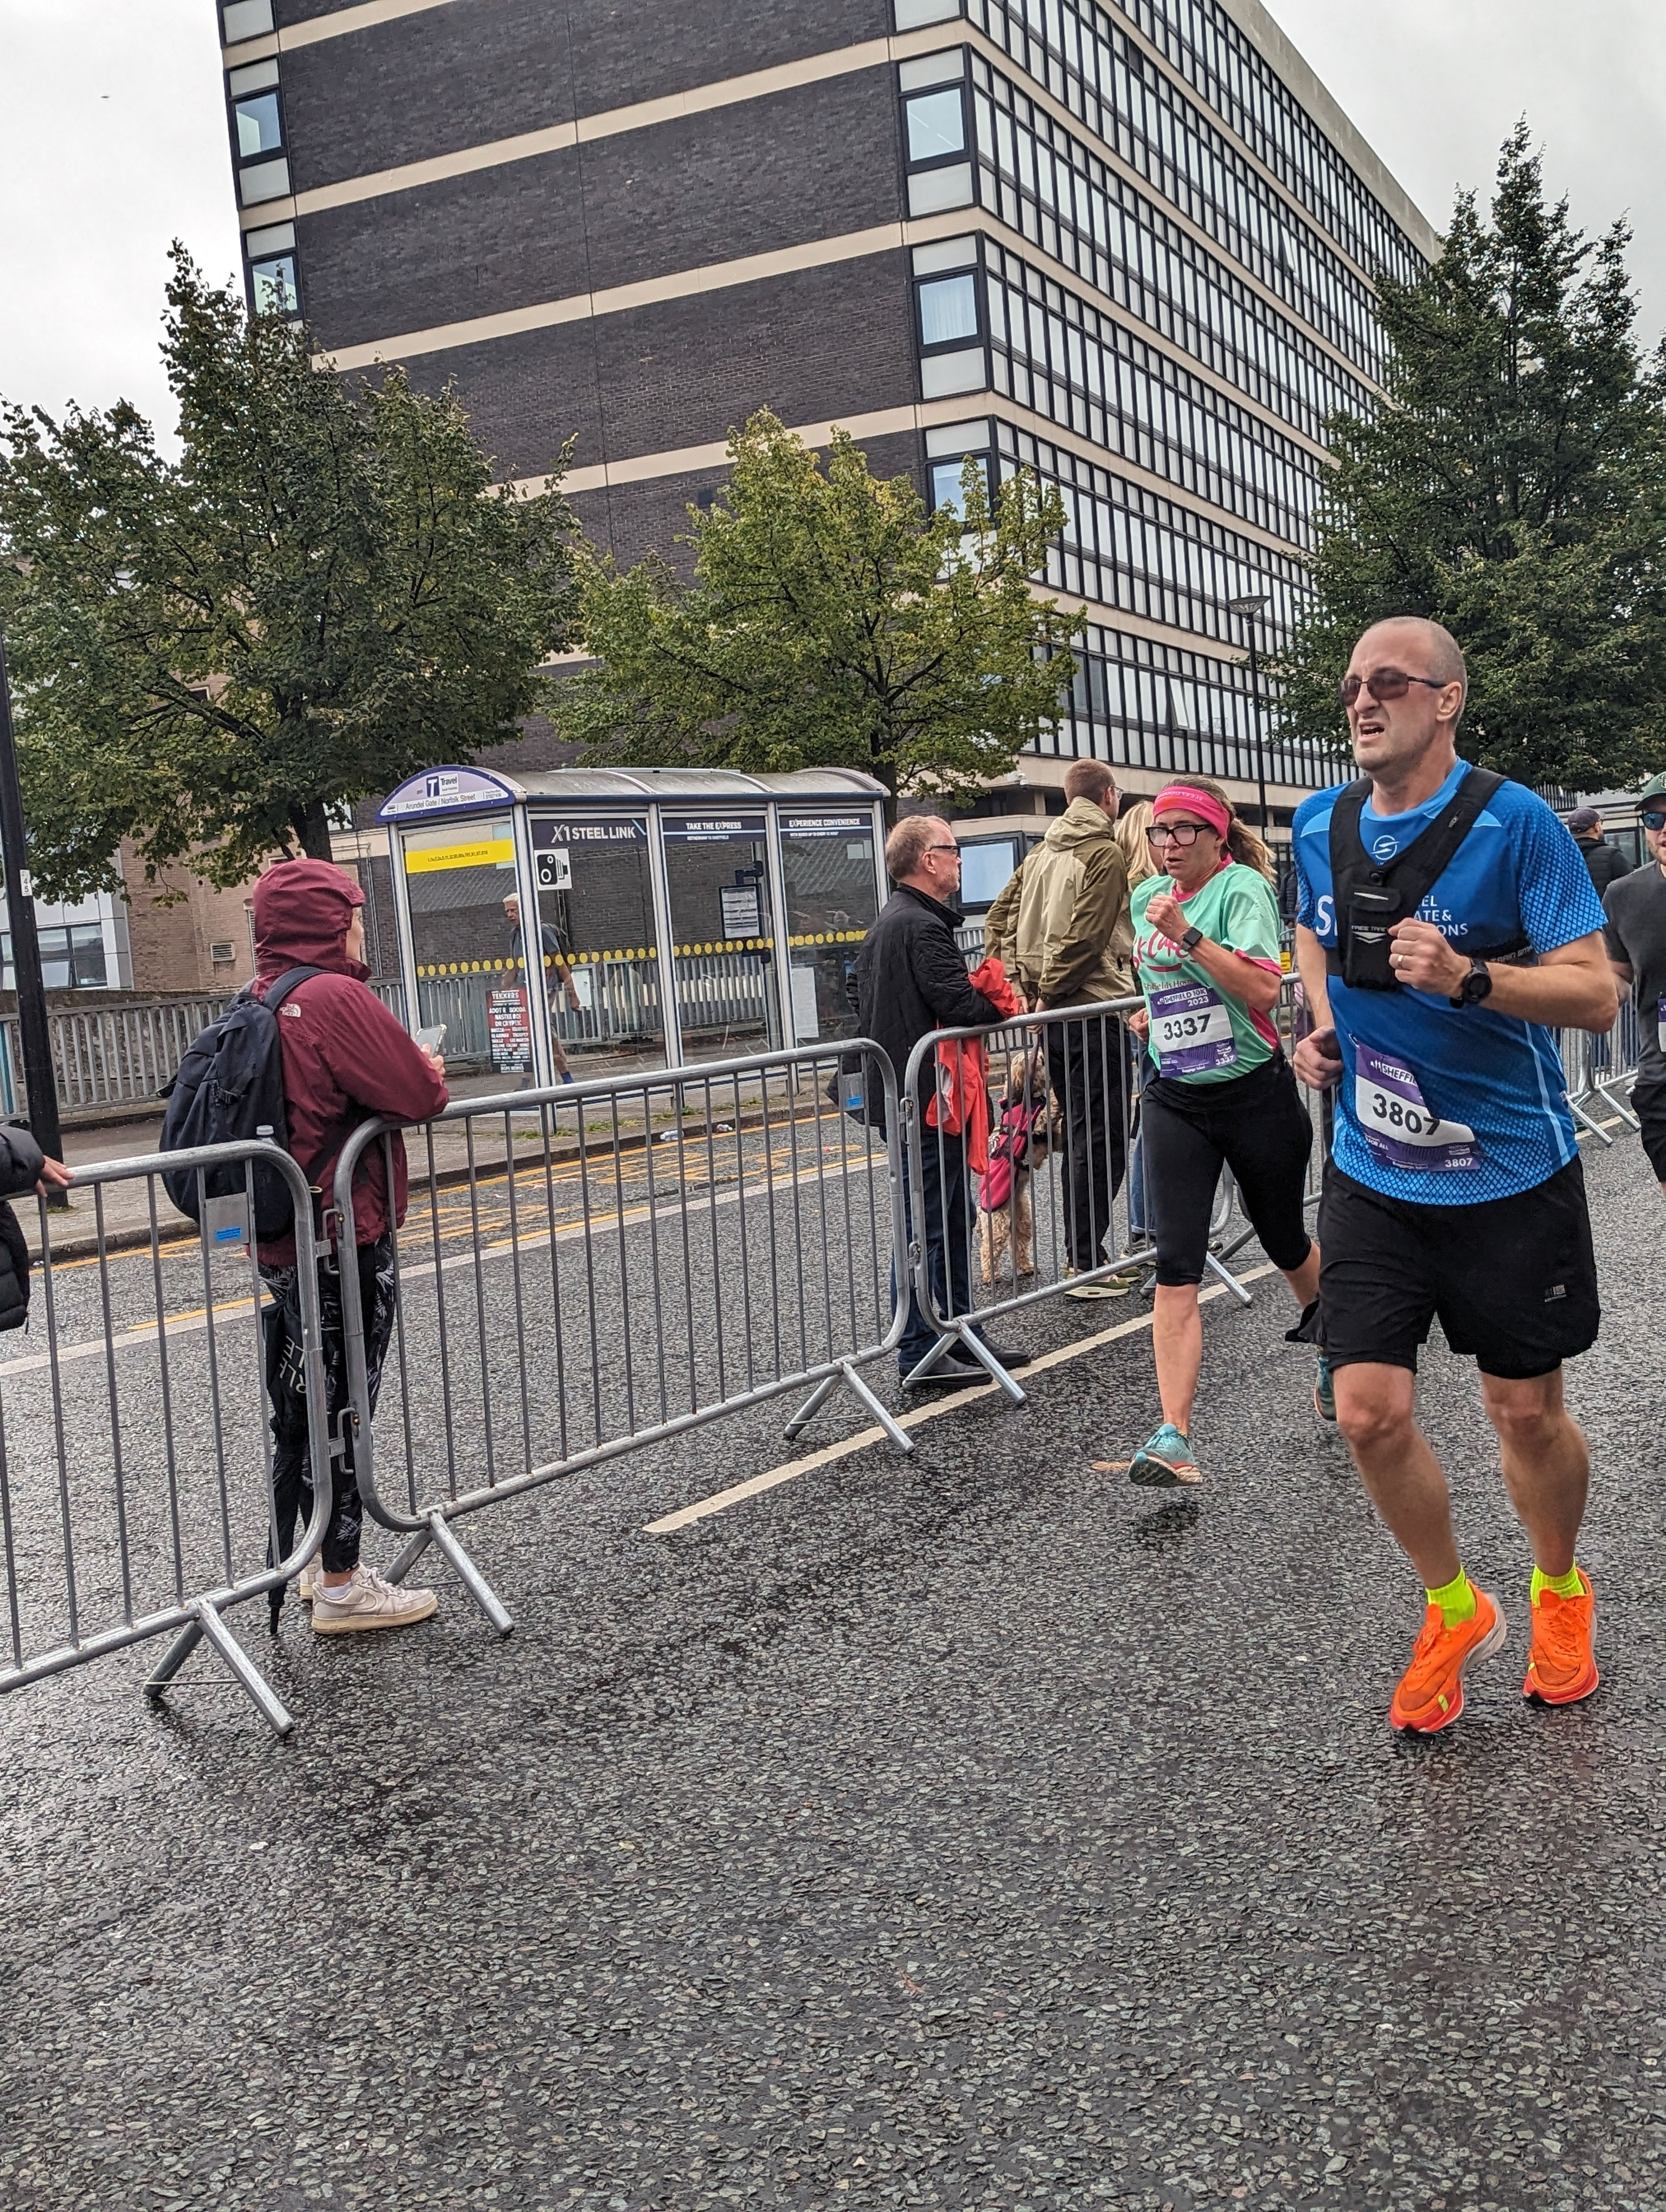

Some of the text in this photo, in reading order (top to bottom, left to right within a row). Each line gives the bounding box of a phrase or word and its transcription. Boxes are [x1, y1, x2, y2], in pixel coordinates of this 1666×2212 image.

[440, 776, 457, 786] Travel
[406, 801, 425, 810] Arundel
[441, 795, 459, 805] Norfolk
[460, 794, 476, 802] Street
[715, 821, 742, 830] EXPRESS
[789, 818, 861, 827] EXPERIENCE CONVENIENCE
[550, 824, 571, 843] X1
[1414, 910, 1440, 921] ATE
[1193, 988, 1207, 996] 10K
[1187, 996, 1209, 1007] 2023
[1163, 1013, 1212, 1040] 3337
[1215, 1054, 1235, 1065] 3337
[1383, 1065, 1417, 1084] SHEFFI
[1373, 1094, 1440, 1135] 3807
[1445, 1158, 1473, 1167] 3807
